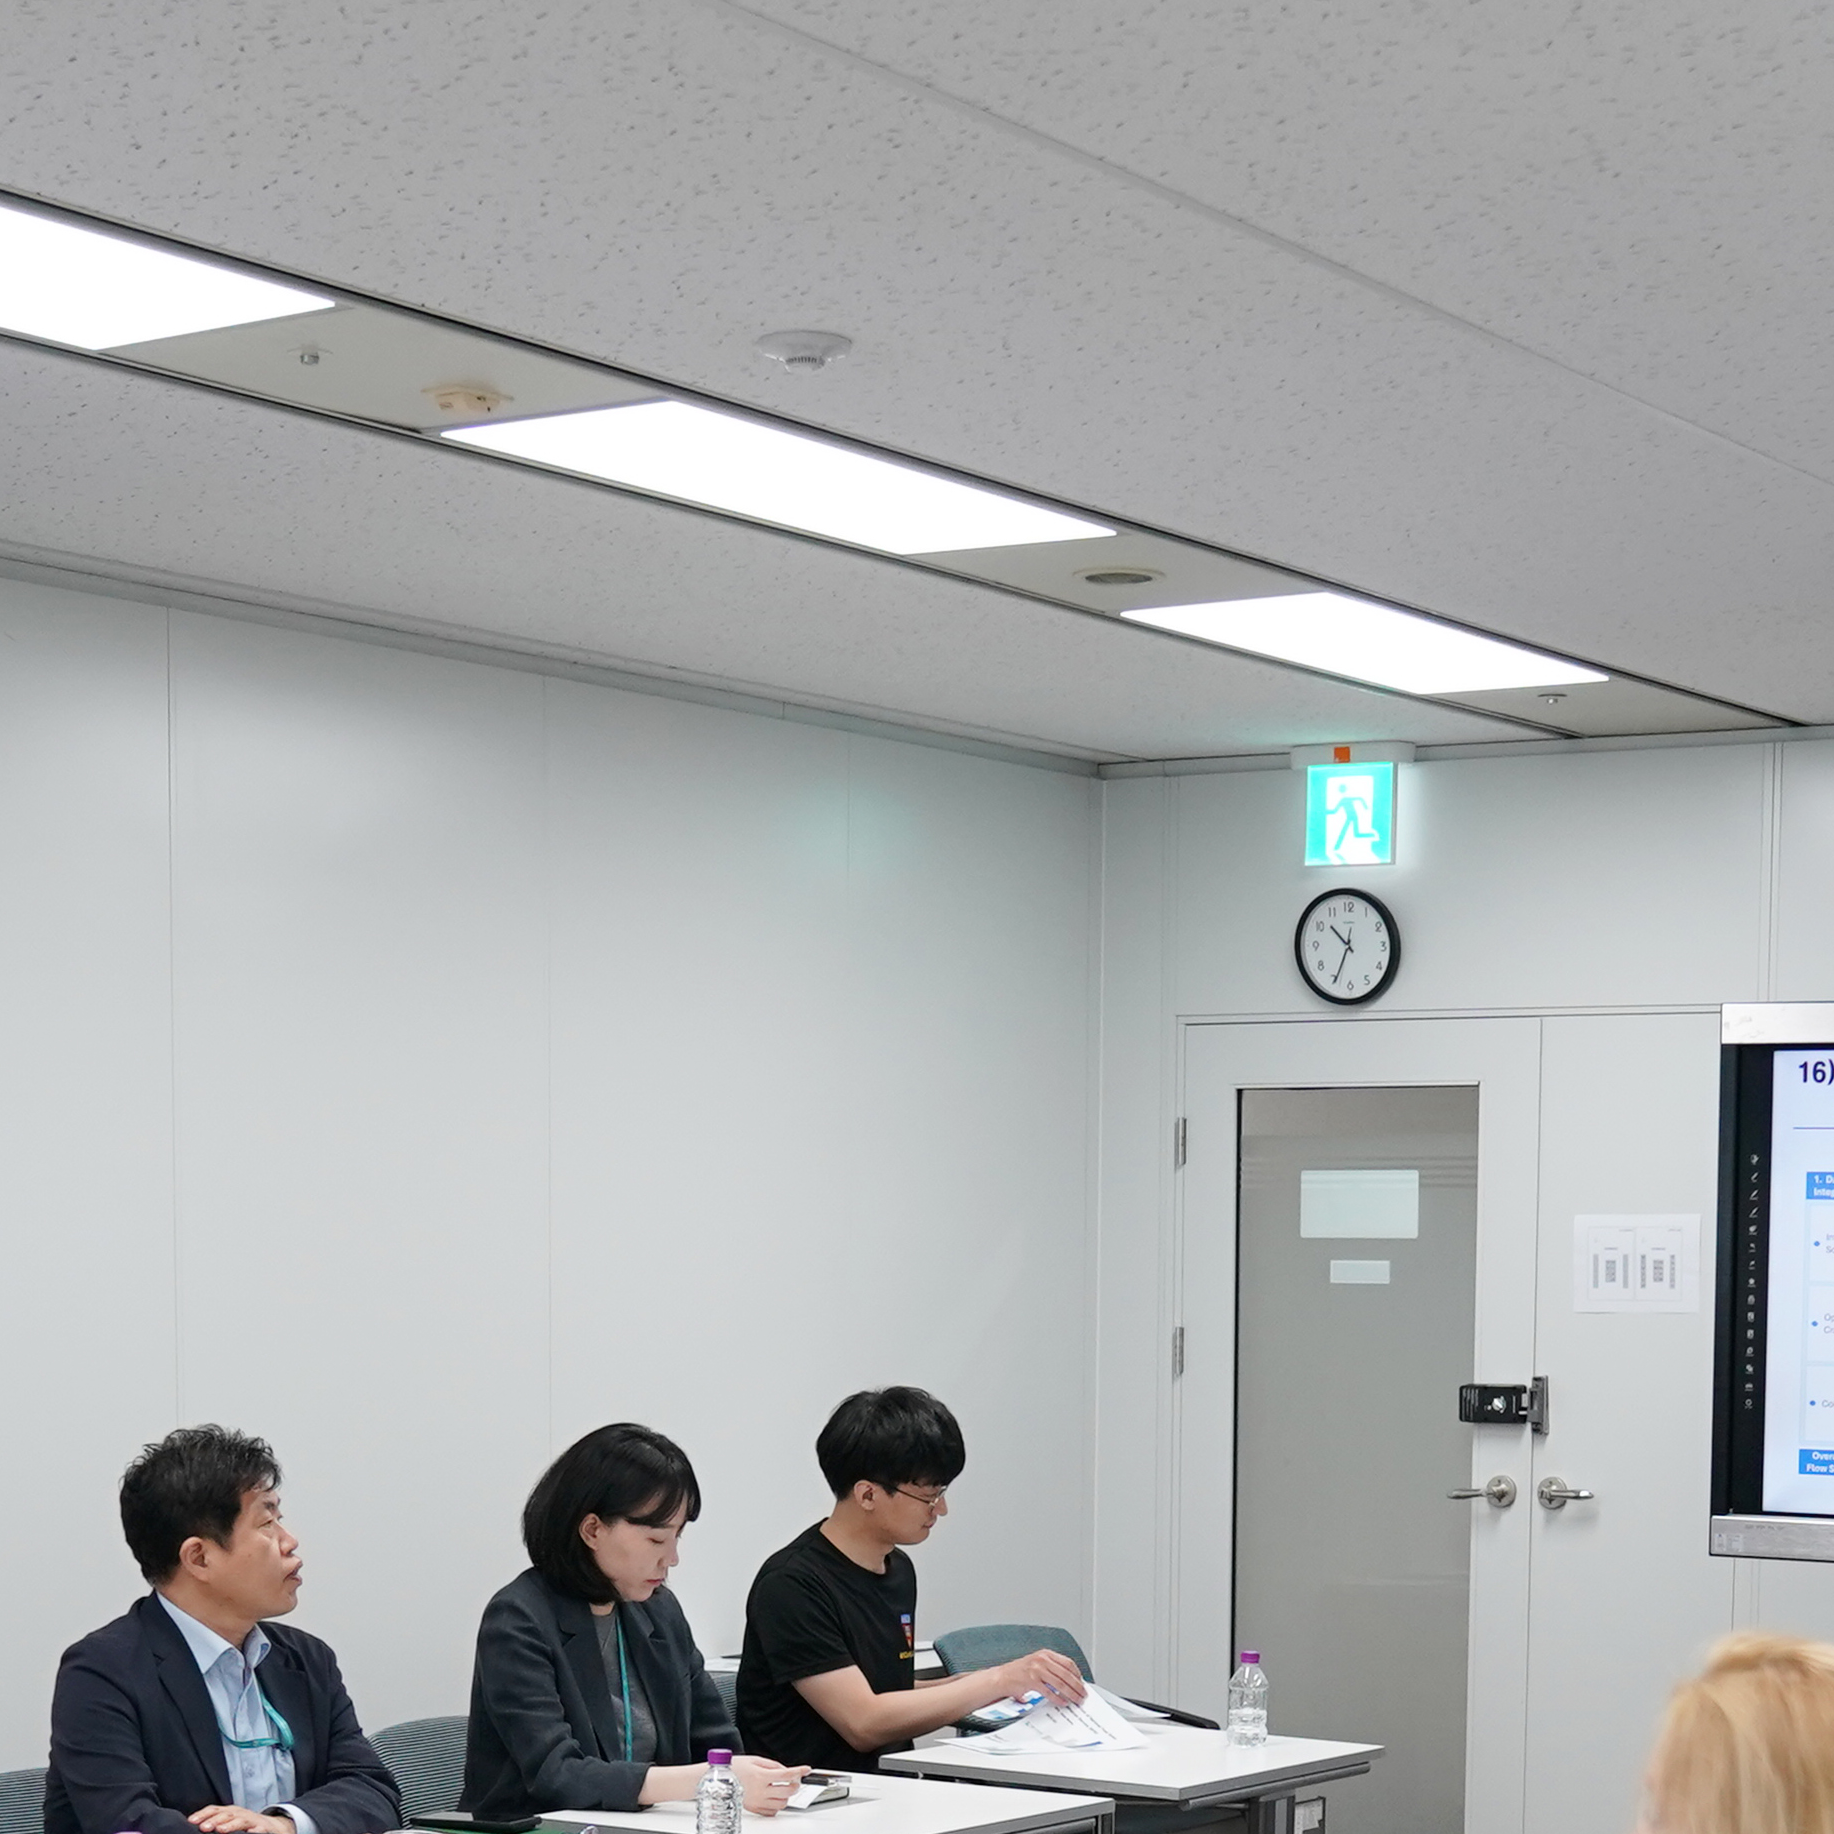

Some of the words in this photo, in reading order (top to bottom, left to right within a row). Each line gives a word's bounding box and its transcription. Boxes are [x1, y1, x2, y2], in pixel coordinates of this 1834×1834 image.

[1329, 907, 1336, 917] 11
[1344, 902, 1354, 912] 12
[1316, 921, 1324, 932] 10
[1375, 921, 1382, 932] 2
[1312, 941, 1319, 951] 9
[1380, 941, 1387, 952] 3
[1318, 960, 1324, 971] 8
[1376, 961, 1382, 970] 4
[1364, 975, 1370, 985] 5
[1347, 981, 1354, 990] 6
